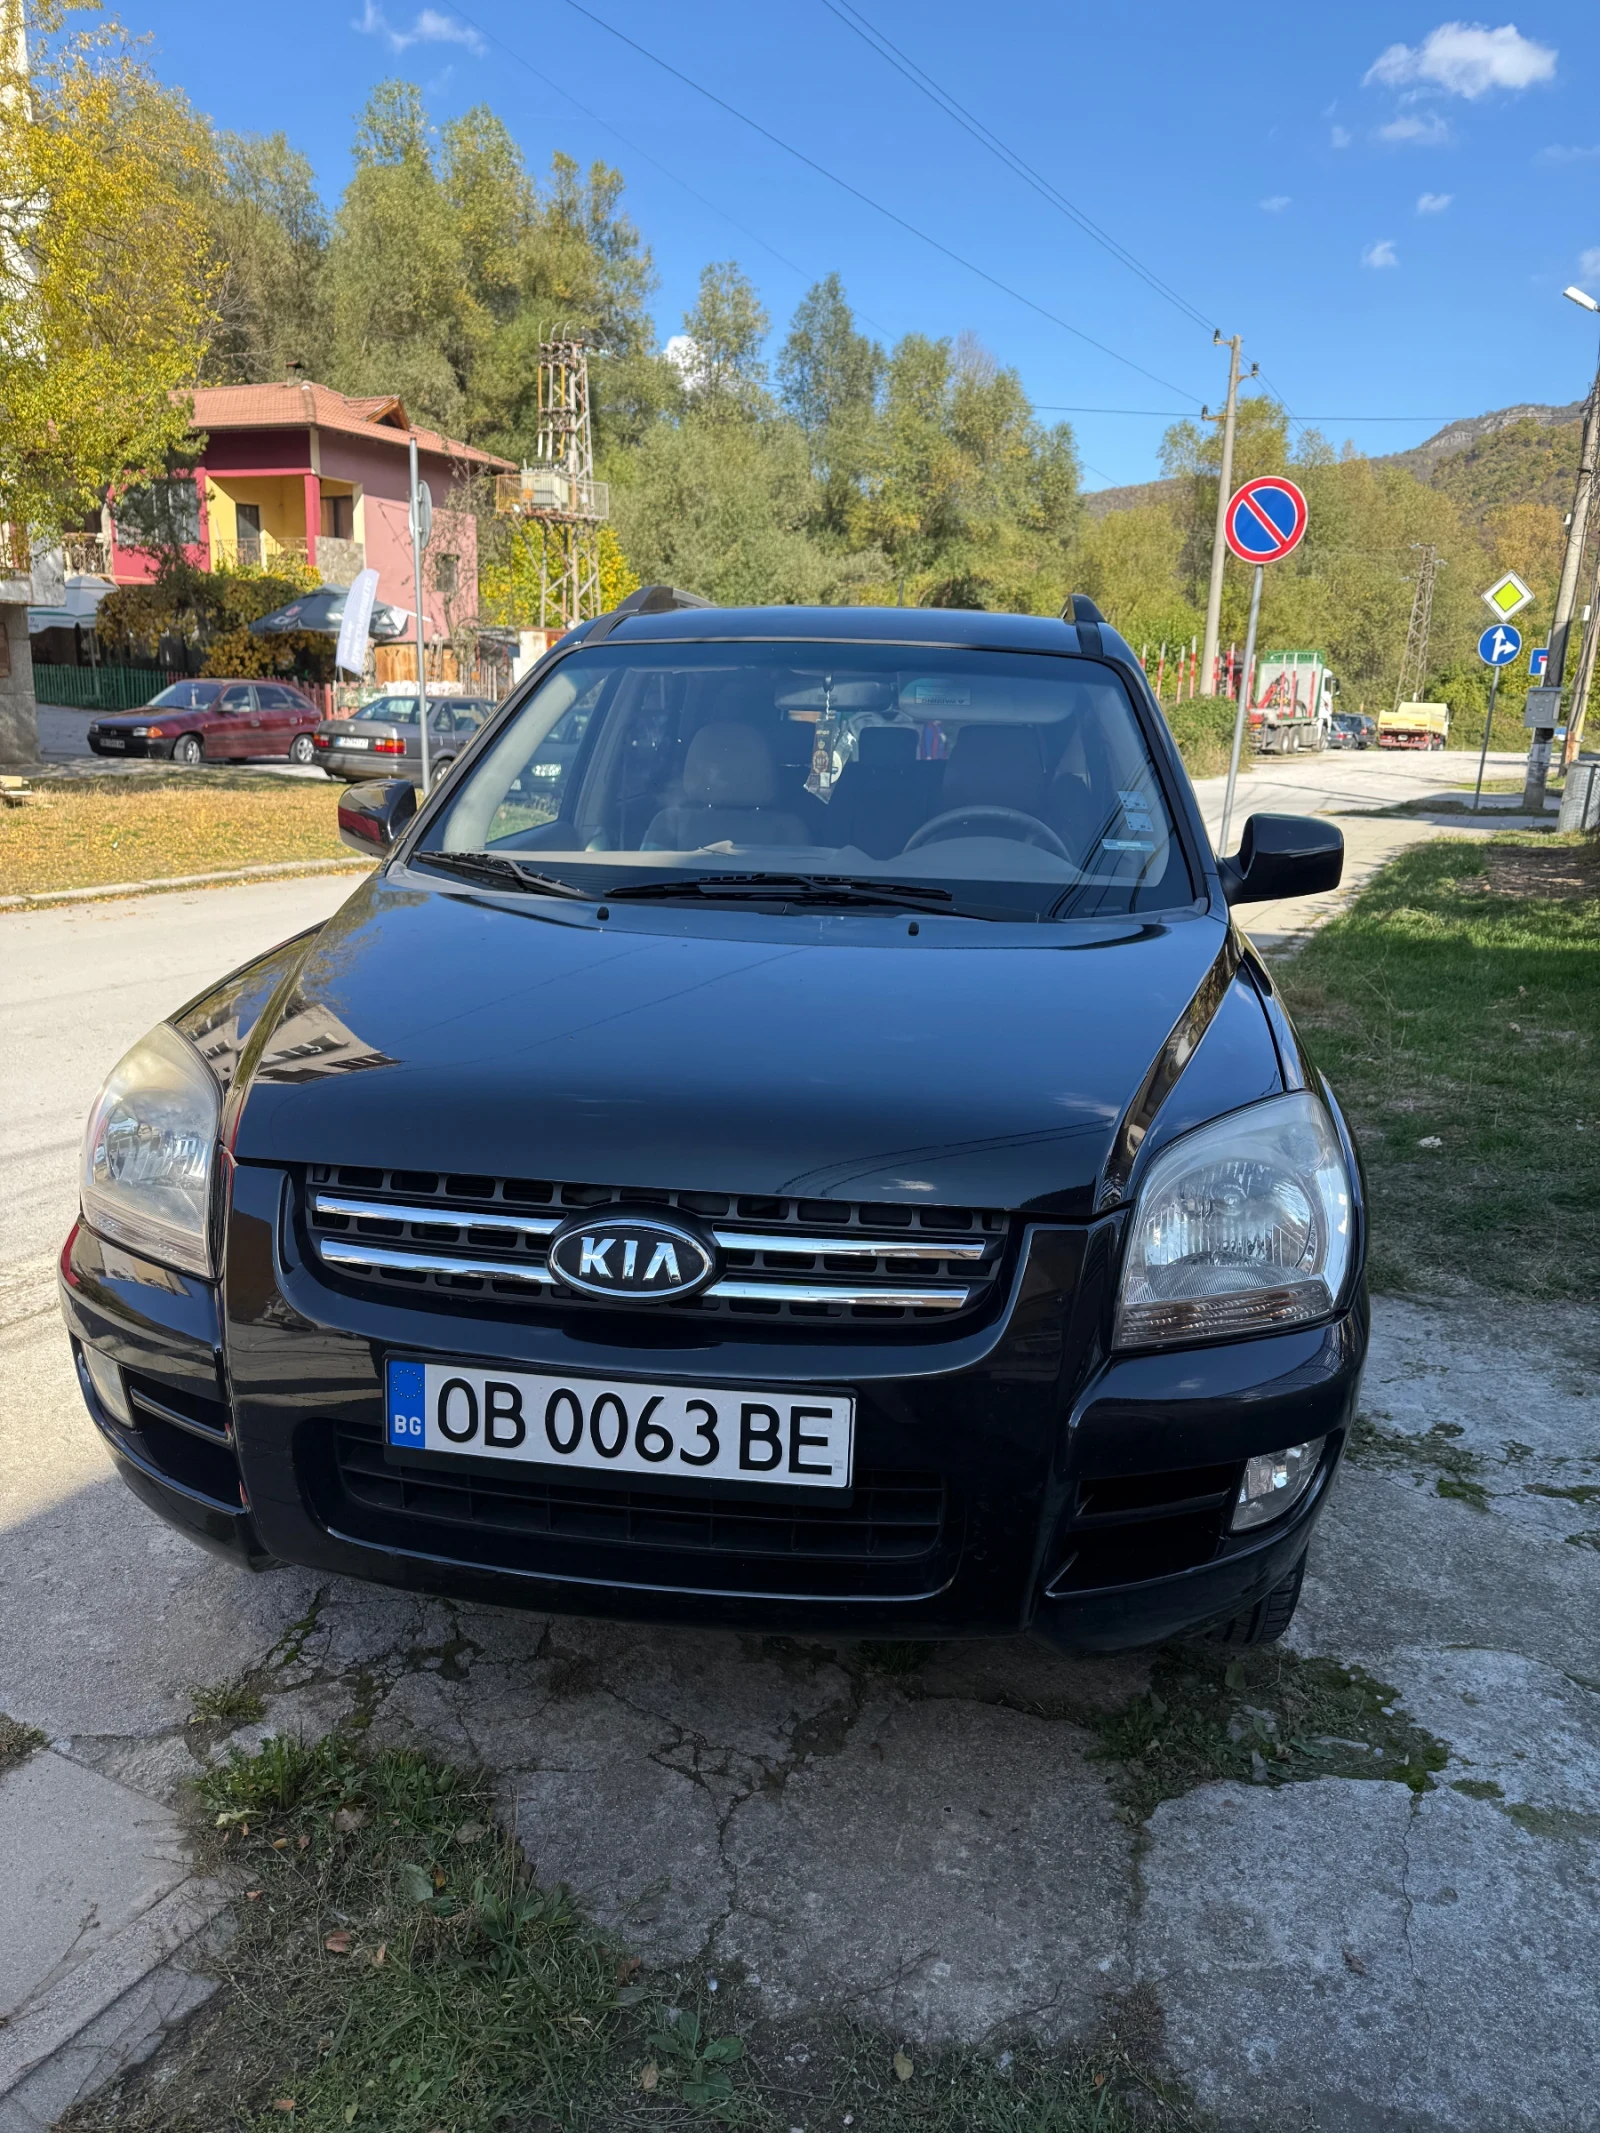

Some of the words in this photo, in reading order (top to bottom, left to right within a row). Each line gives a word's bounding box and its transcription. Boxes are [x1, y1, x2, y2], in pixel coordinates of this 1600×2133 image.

[578, 1236, 682, 1284] KIA
[394, 1414, 422, 1436] BG
[437, 1377, 527, 1448] OB
[545, 1388, 720, 1467] 0063
[740, 1402, 833, 1475] BE
